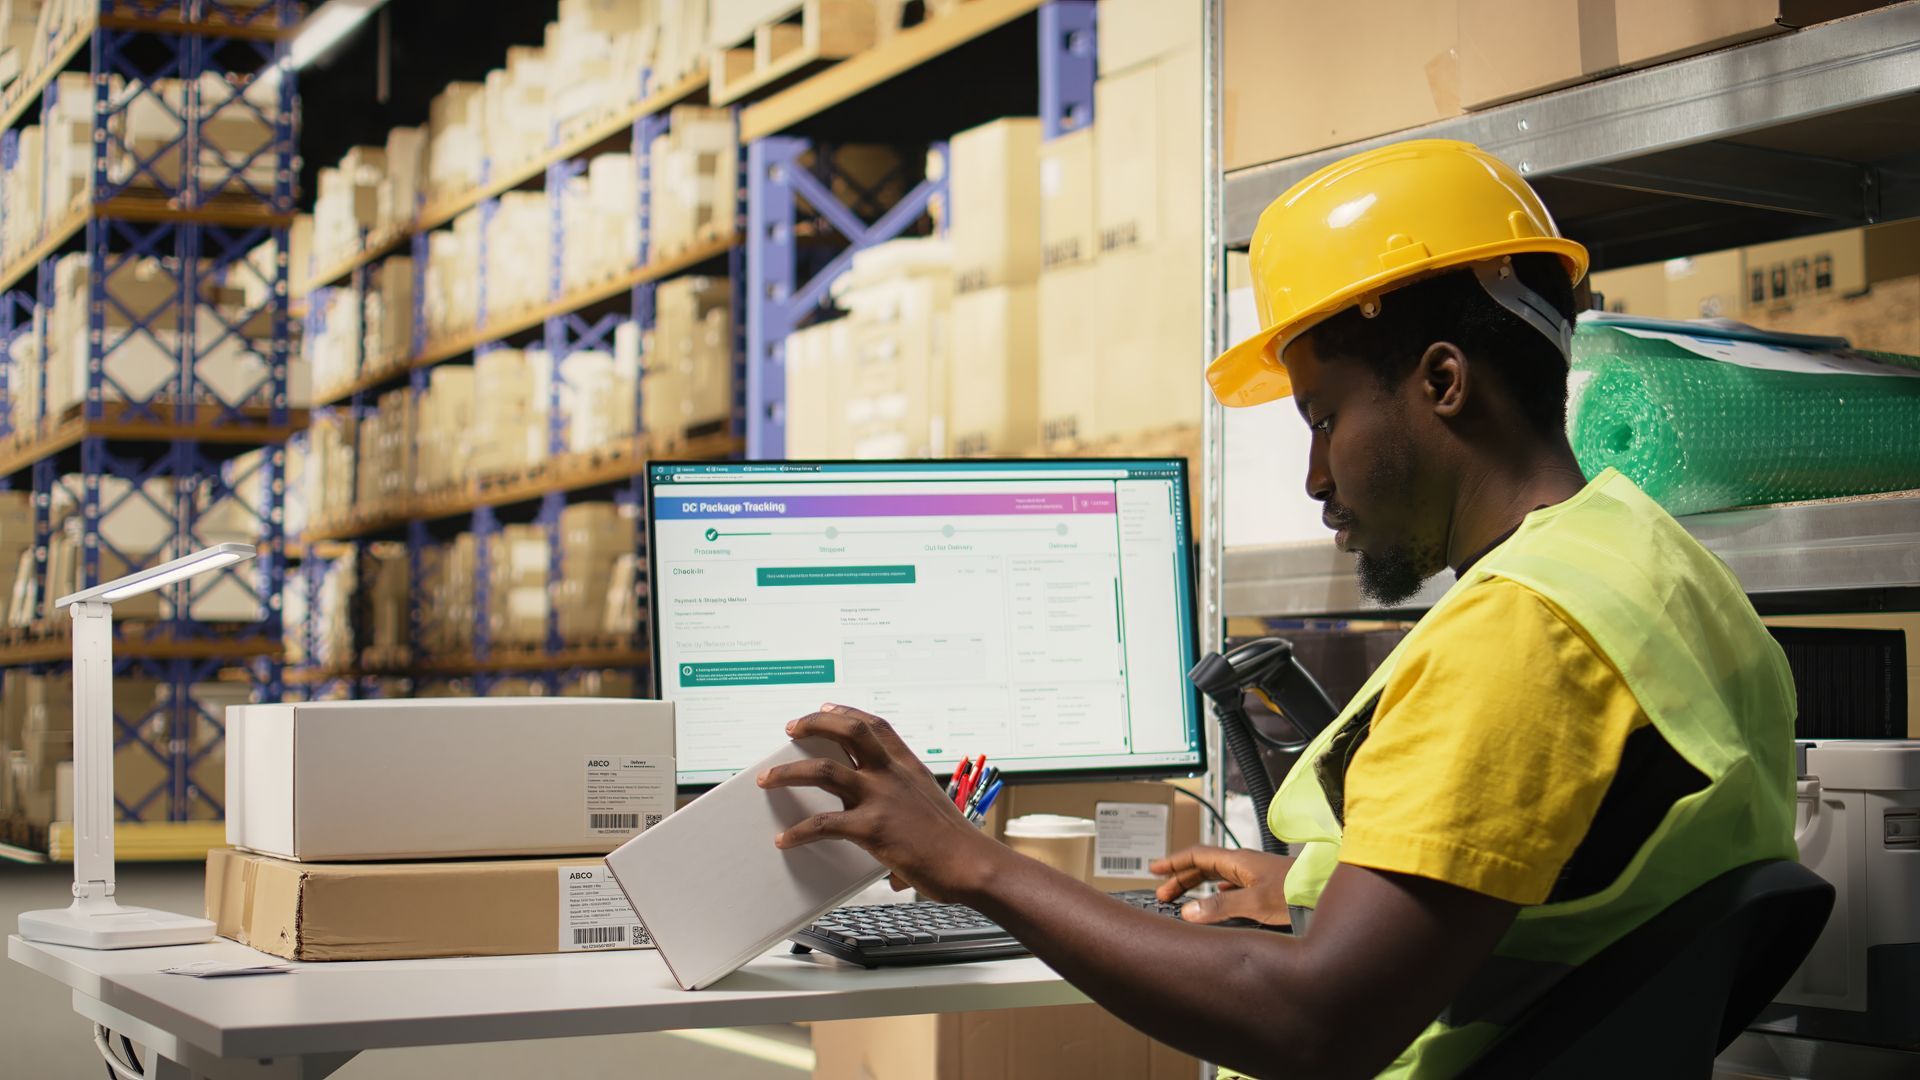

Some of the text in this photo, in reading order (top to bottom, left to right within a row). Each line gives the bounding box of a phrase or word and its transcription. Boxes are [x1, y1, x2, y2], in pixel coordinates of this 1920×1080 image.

[682, 502, 786, 514] DC Package Tracking
[694, 548, 731, 556] Processing
[570, 872, 593, 880] ABCO
